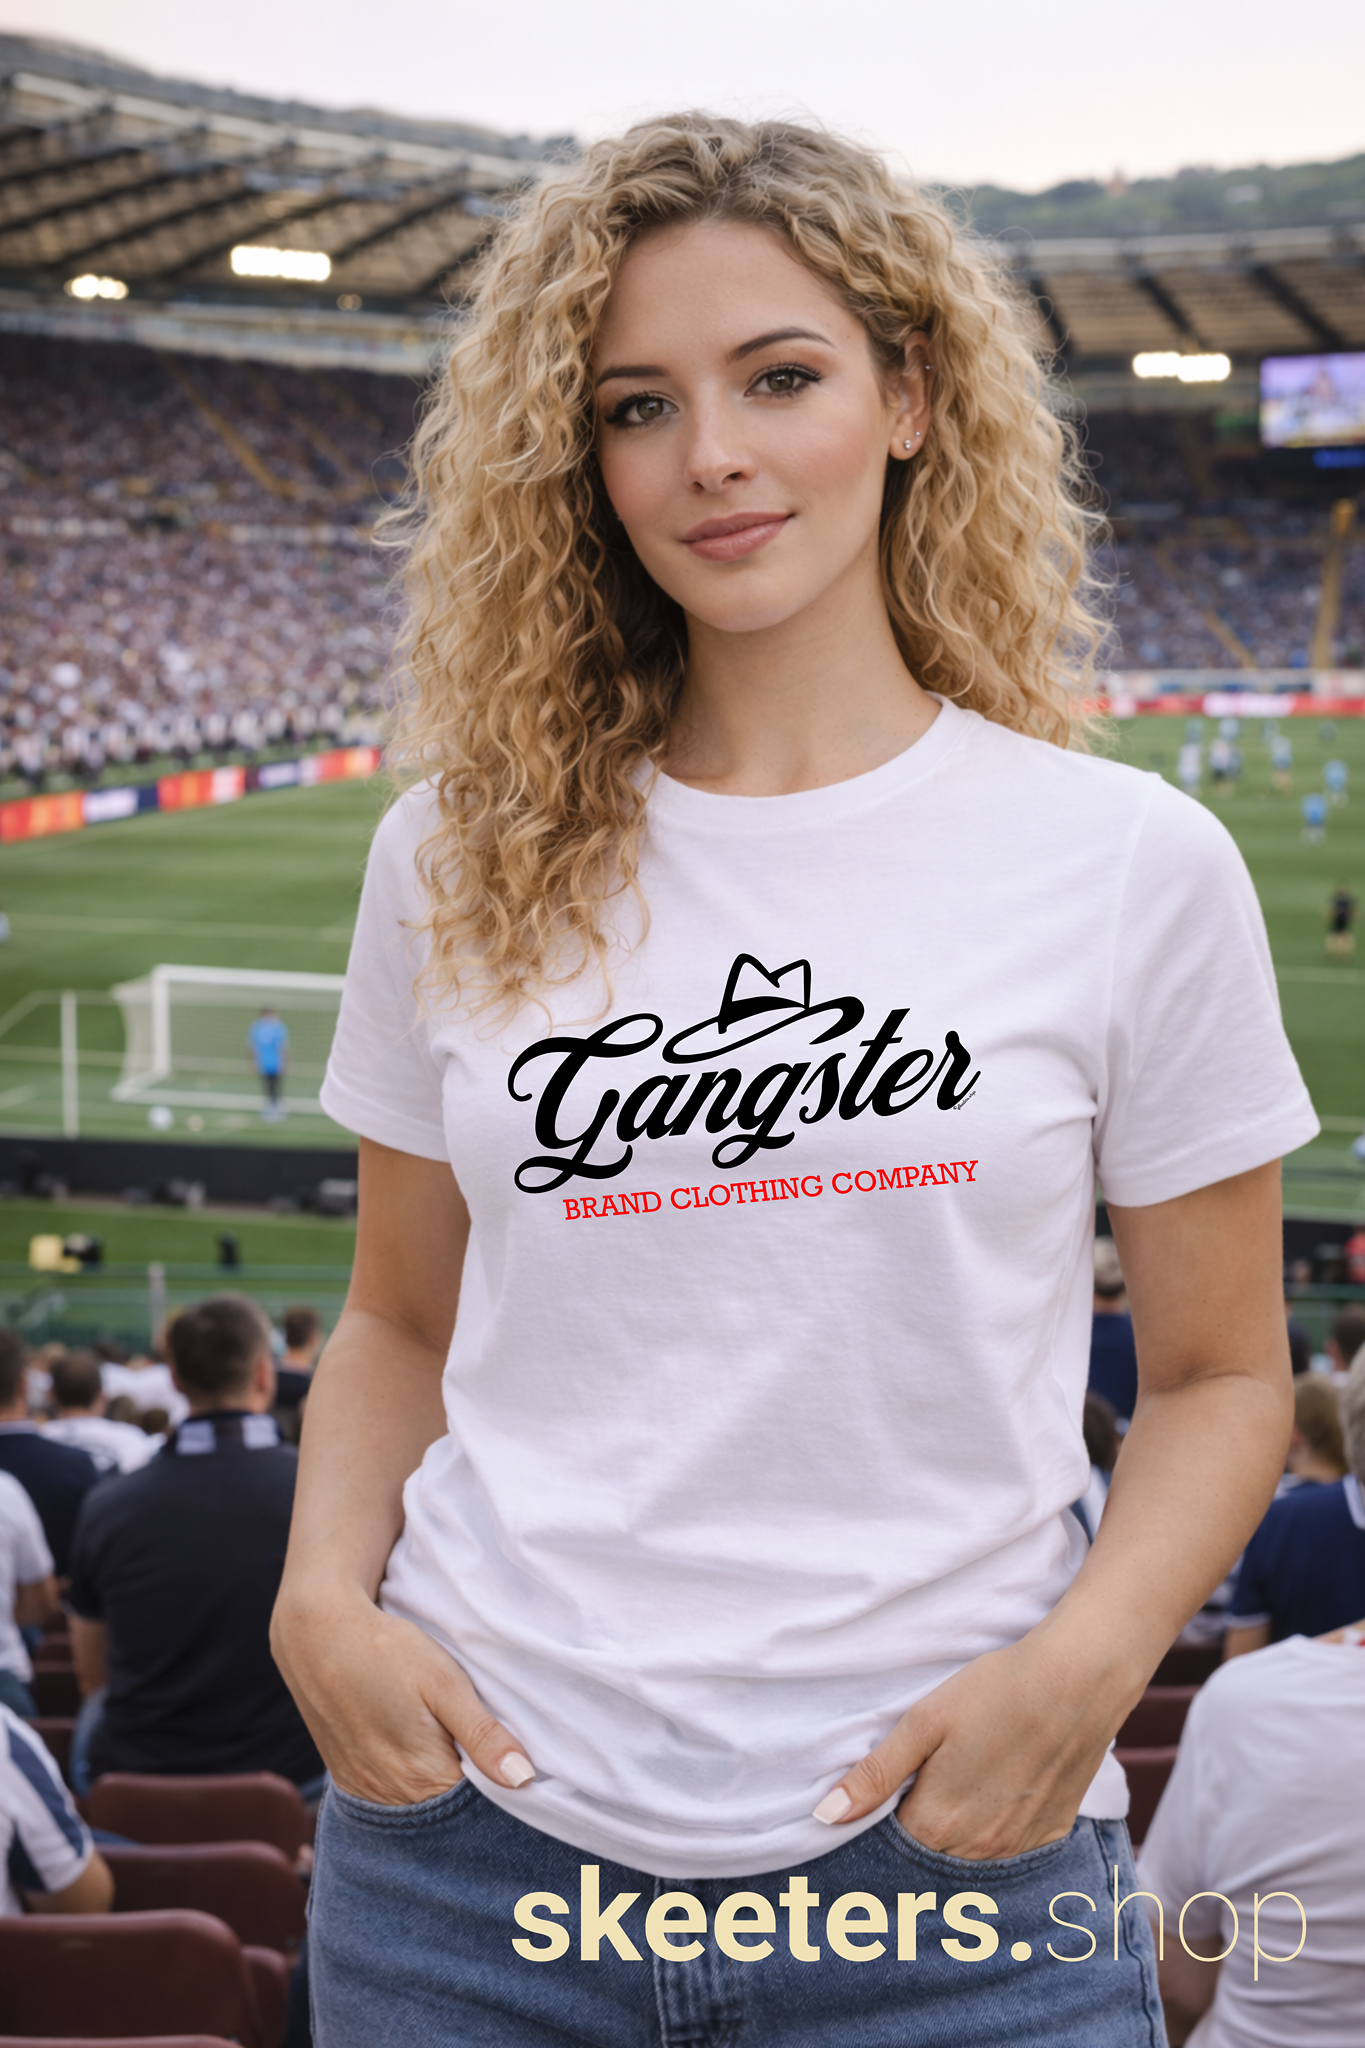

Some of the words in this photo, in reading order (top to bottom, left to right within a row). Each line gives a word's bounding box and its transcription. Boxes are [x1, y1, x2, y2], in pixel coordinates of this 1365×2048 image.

[508, 1009, 981, 1193] Gangster
[563, 1191, 662, 1220] BRAND
[670, 1175, 824, 1210] CLOTHING
[831, 1160, 979, 1195] COMPANY
